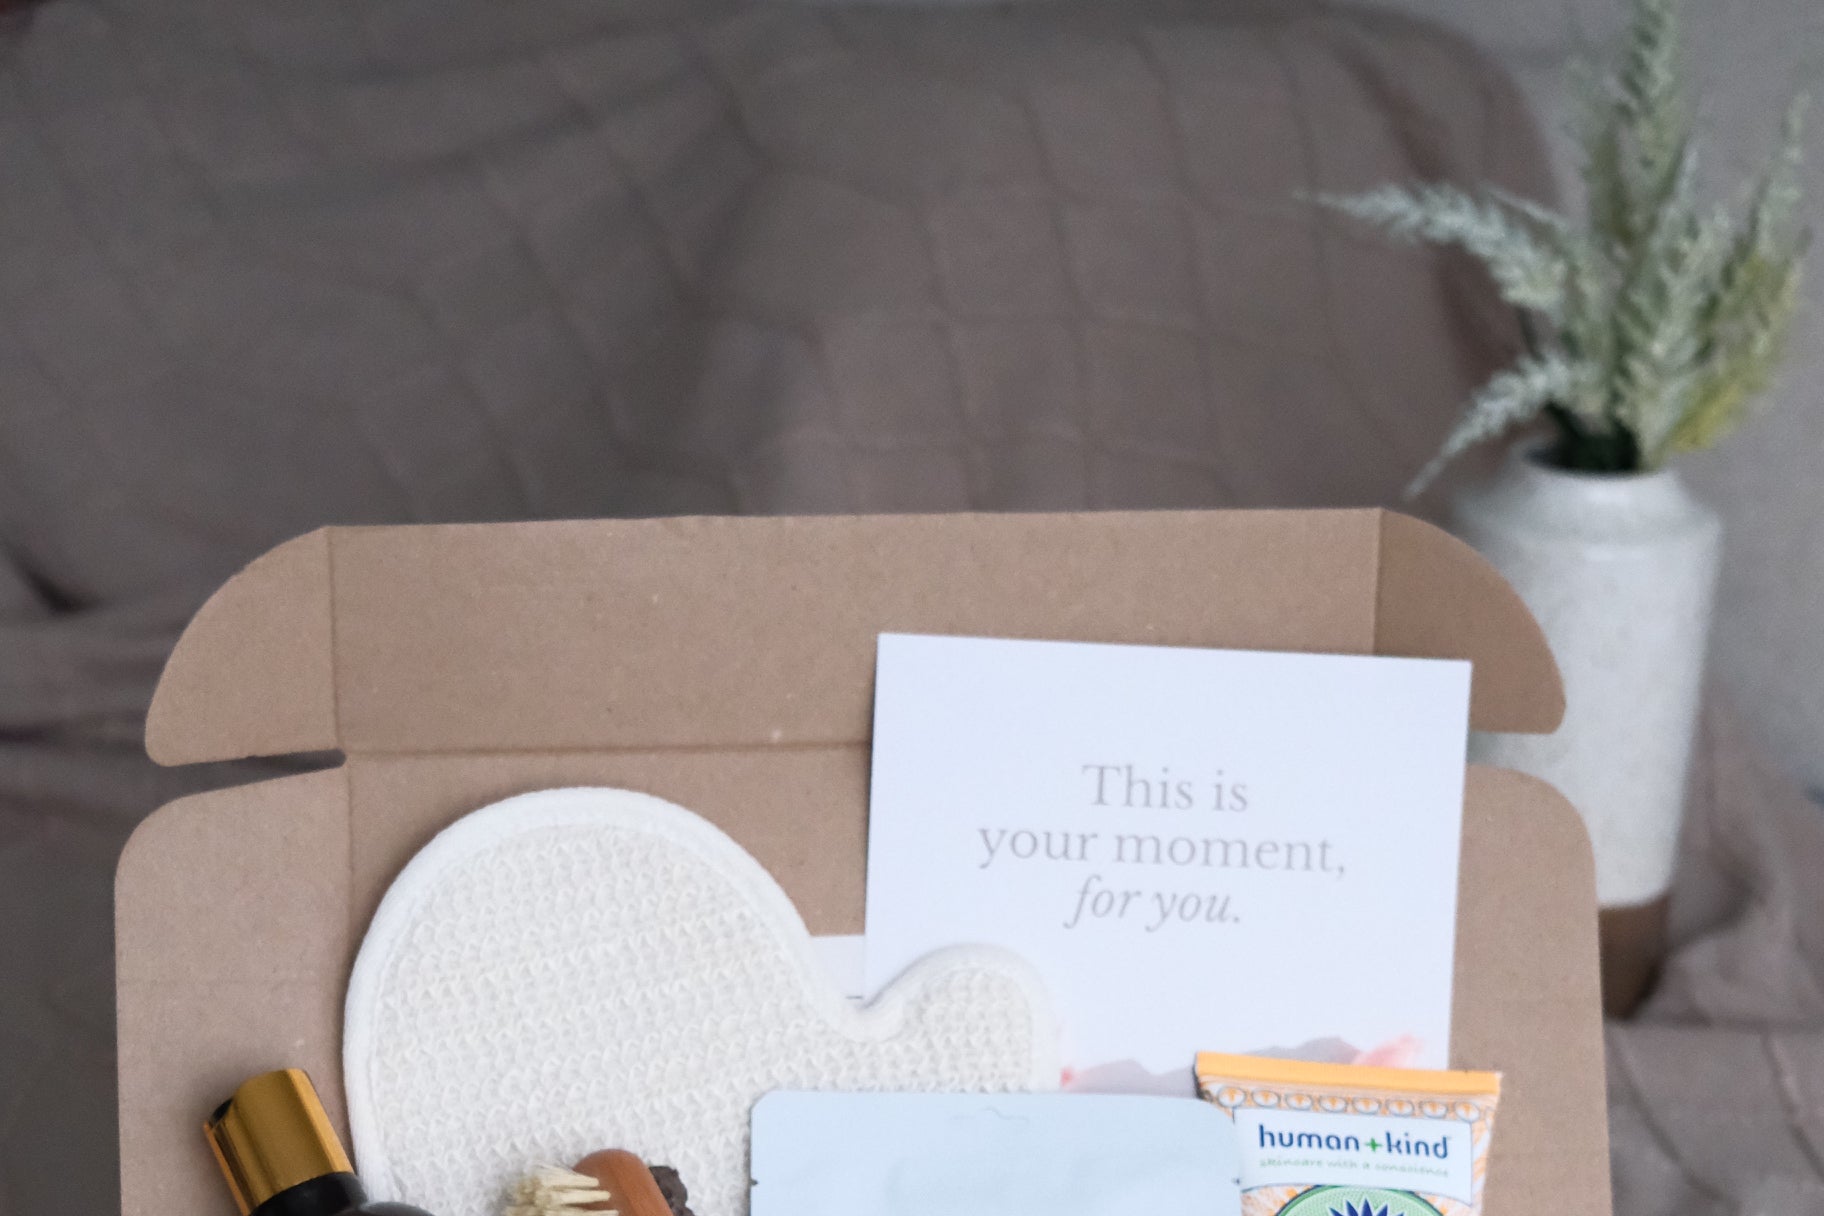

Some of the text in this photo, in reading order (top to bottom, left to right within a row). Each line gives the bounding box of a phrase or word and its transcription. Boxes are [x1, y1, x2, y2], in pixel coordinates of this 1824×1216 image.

[1082, 763, 1249, 813] This is
[978, 826, 1346, 879] your moment,
[1062, 874, 1242, 933] for you.
